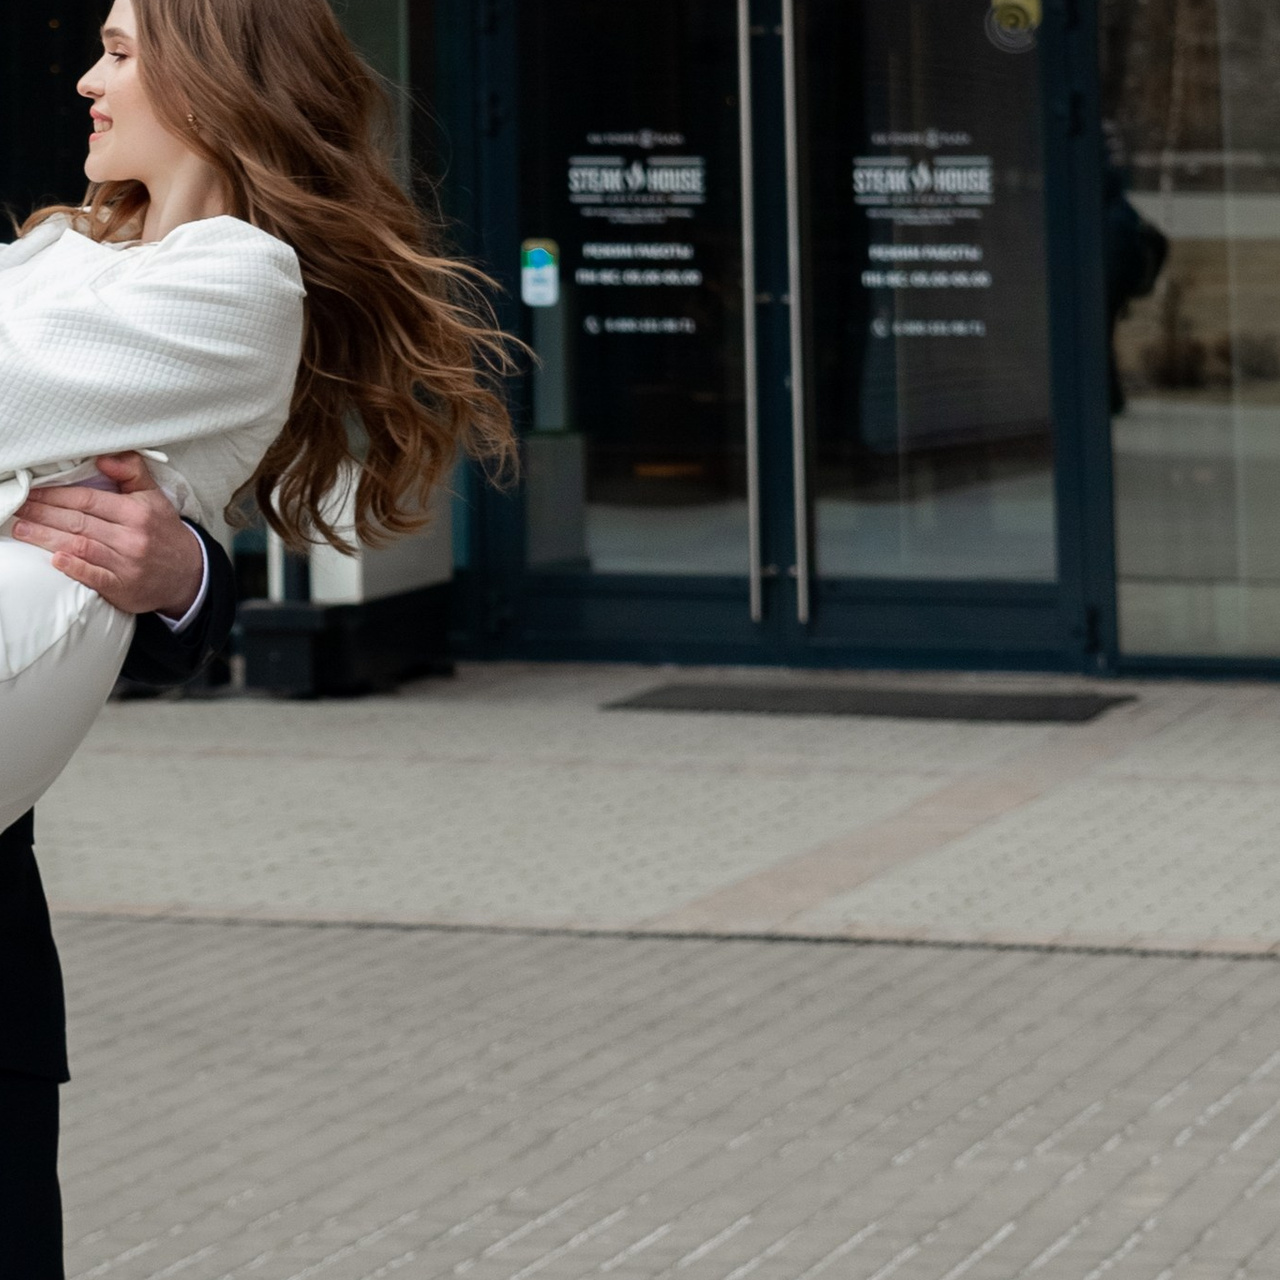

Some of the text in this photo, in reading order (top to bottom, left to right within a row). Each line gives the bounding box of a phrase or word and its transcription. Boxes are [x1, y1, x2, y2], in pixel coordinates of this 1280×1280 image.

[569, 168, 702, 193] STEAK HOUSE
[853, 169, 991, 193] STEAK HOUSE
